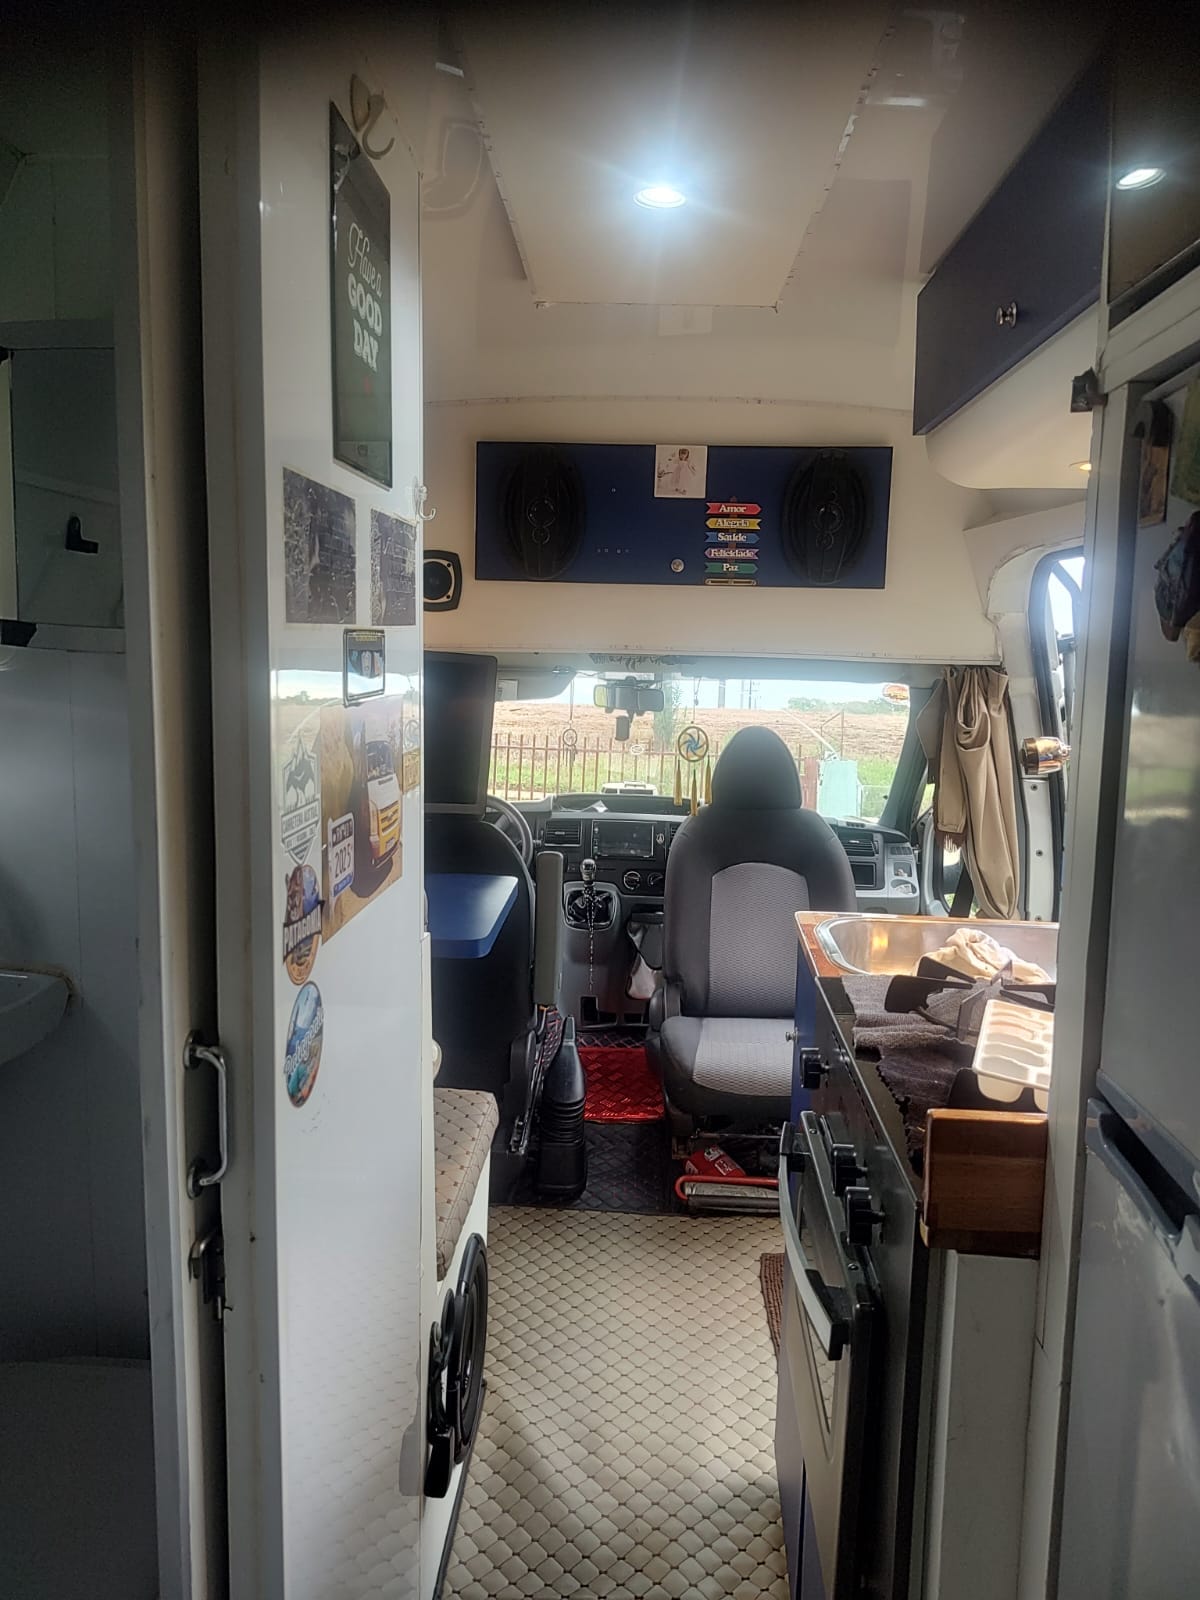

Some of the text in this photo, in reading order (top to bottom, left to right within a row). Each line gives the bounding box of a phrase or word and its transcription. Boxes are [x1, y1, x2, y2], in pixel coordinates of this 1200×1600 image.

[348, 222, 376, 290] Have
[347, 273, 382, 336] GOOD
[353, 319, 379, 372] DAY
[719, 504, 747, 513] Amor
[710, 549, 754, 558] Felicidade
[723, 563, 739, 572] Paz
[284, 905, 322, 957] PATAGONIA
